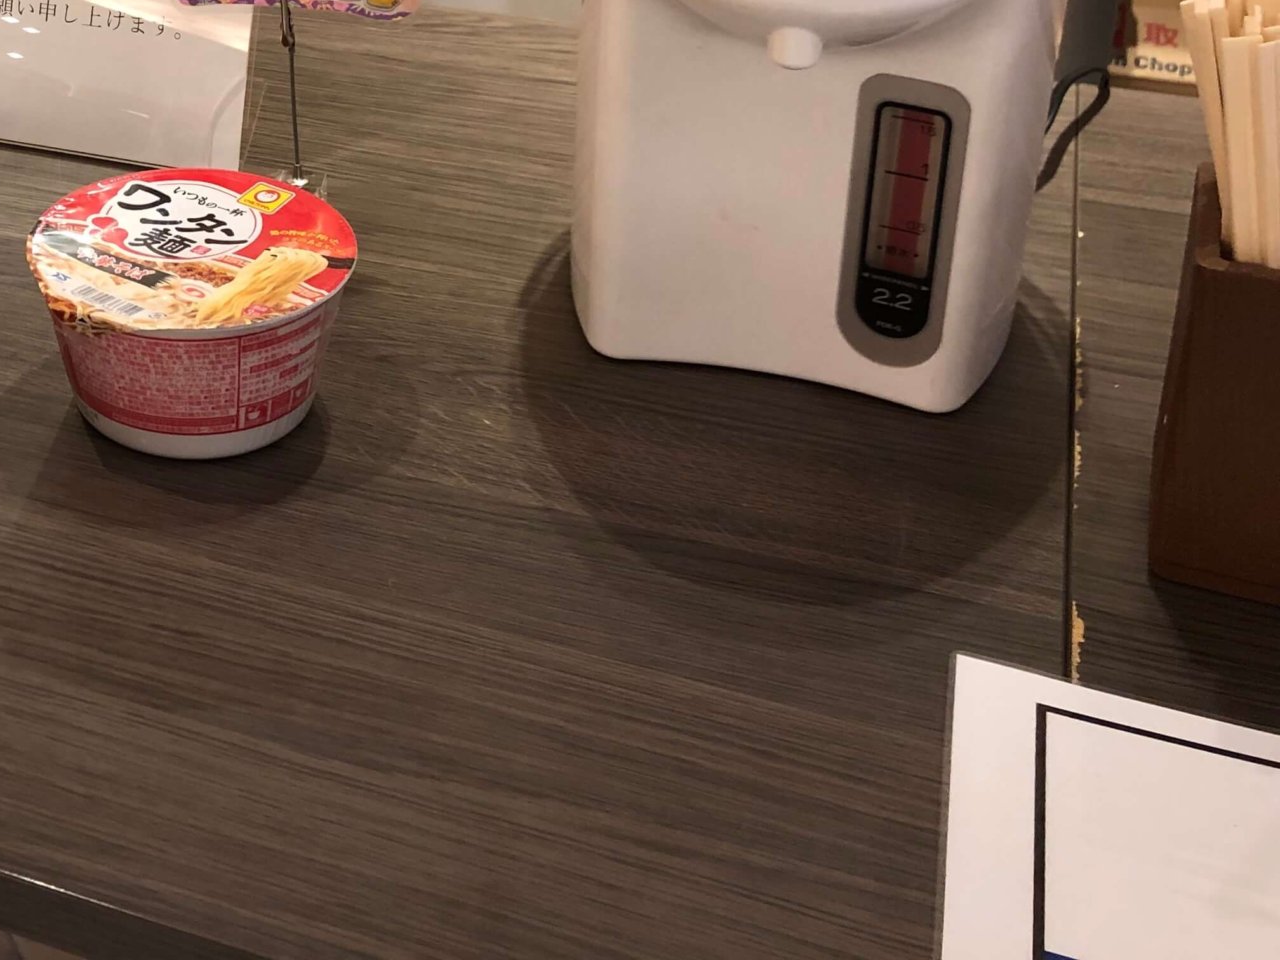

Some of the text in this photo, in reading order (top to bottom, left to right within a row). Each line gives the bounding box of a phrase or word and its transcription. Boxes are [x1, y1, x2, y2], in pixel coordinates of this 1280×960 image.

[173, 186, 246, 218] いつもの一杯
[871, 288, 913, 311] 2.2
